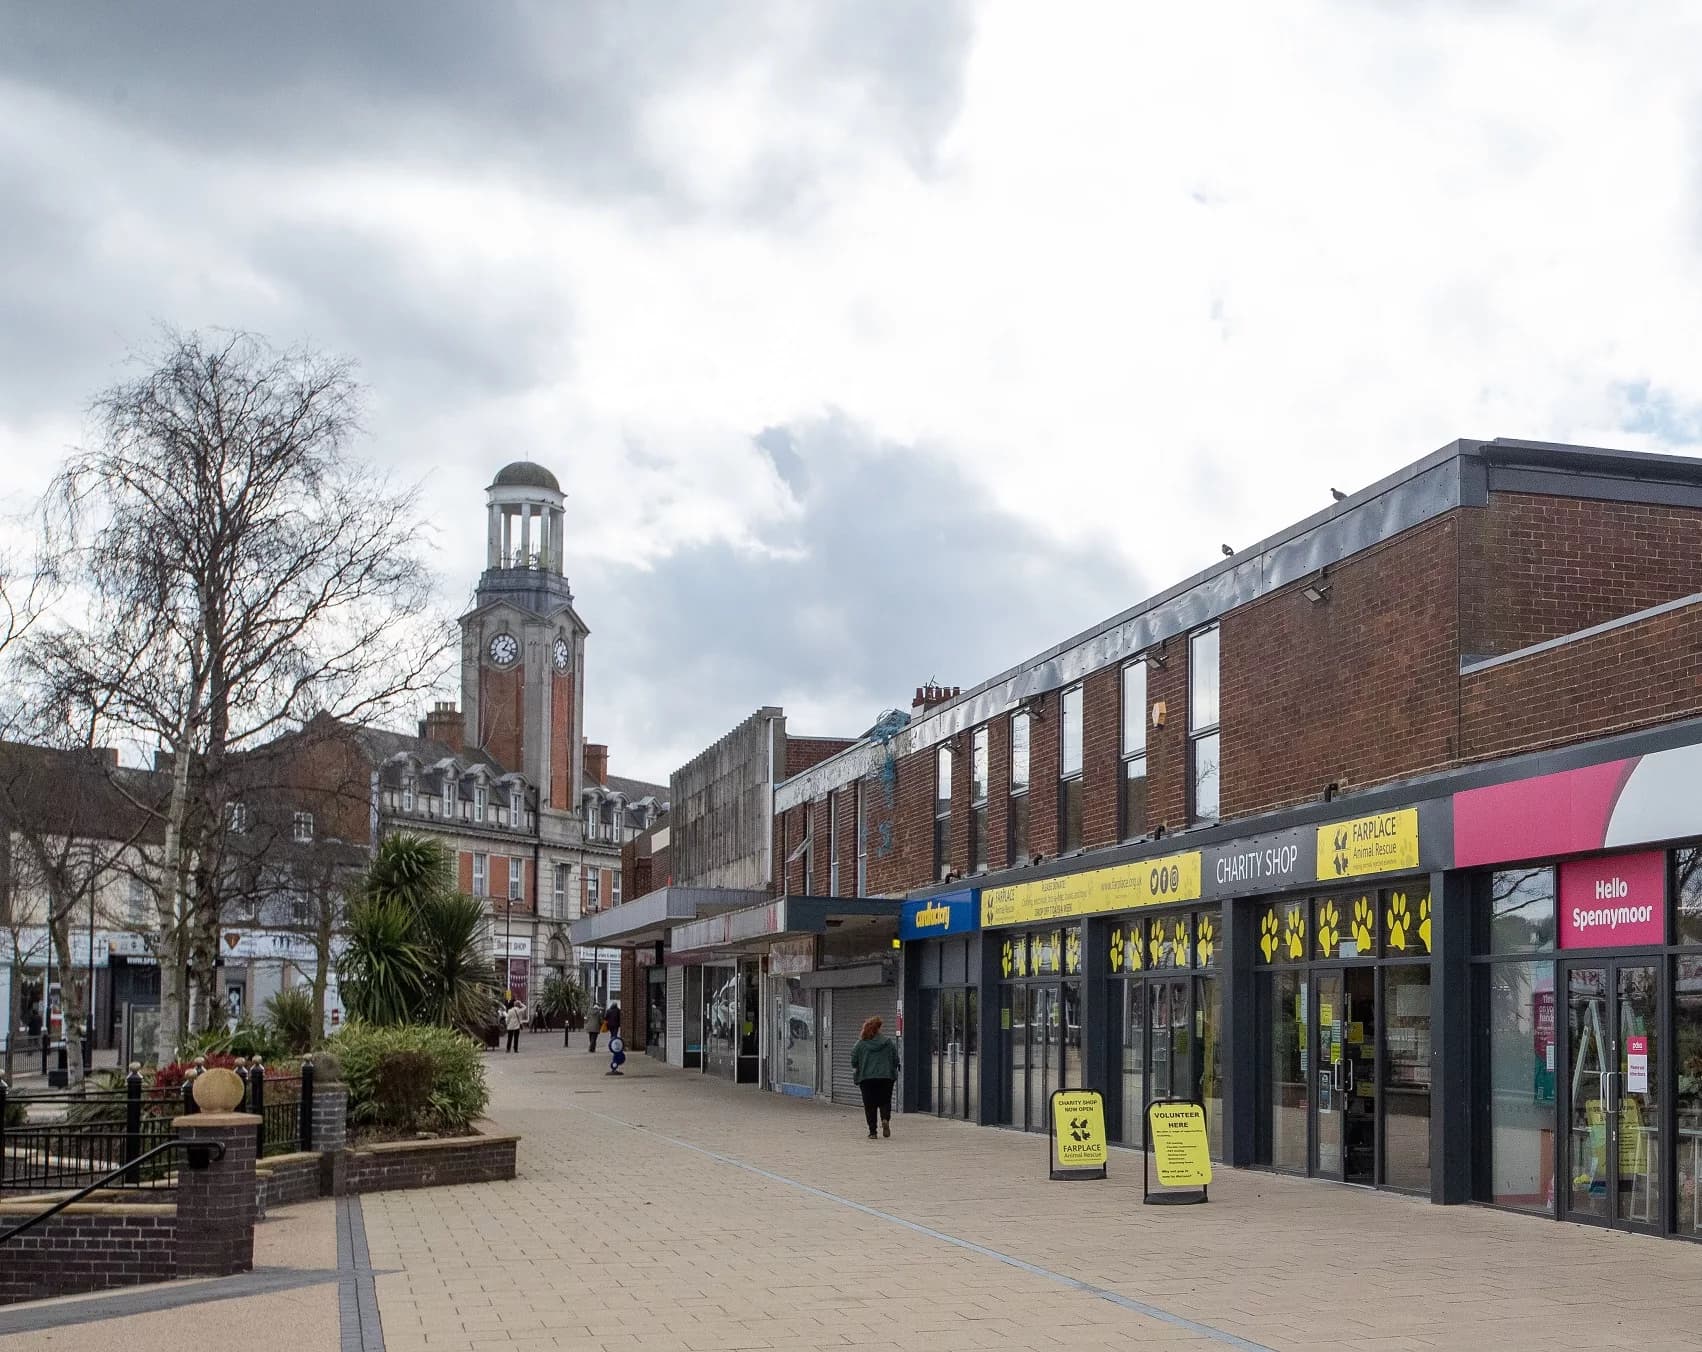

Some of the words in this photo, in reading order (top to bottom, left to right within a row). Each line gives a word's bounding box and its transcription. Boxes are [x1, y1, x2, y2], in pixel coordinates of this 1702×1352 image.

[1353, 817, 1396, 842] FARPLACE
[1354, 843, 1374, 859] Animal
[1375, 842, 1397, 856] Rescue
[1216, 851, 1263, 884] CHARITY
[1265, 845, 1298, 876] SHOP
[1595, 877, 1628, 900] Hello
[1573, 905, 1653, 931] Spennymoor
[1063, 1144, 1101, 1152] FARPLACE
